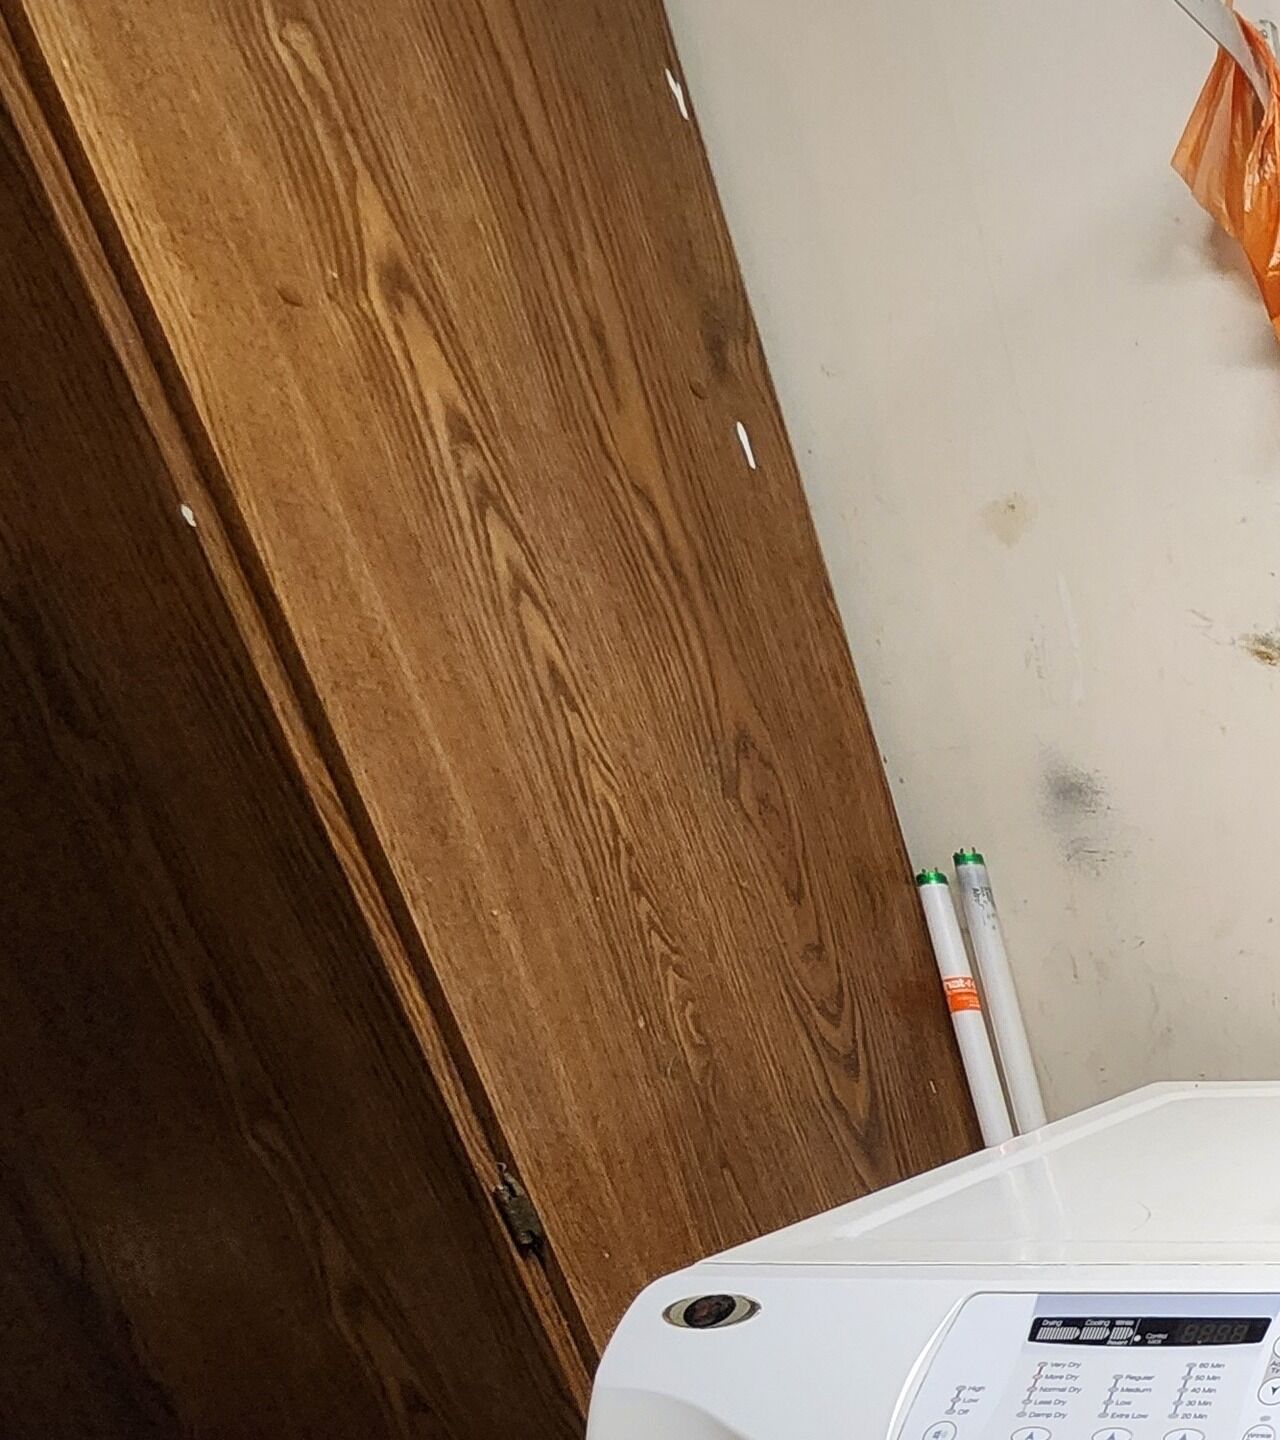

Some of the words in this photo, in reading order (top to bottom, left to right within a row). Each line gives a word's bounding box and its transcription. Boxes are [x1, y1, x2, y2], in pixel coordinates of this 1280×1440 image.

[1085, 1319, 1110, 1327] Cooling
[1050, 1361, 1066, 1369] Very
[1067, 1361, 1081, 1369] Dry
[1068, 1386, 1082, 1394] Dry
[1028, 1411, 1051, 1419] Damp
